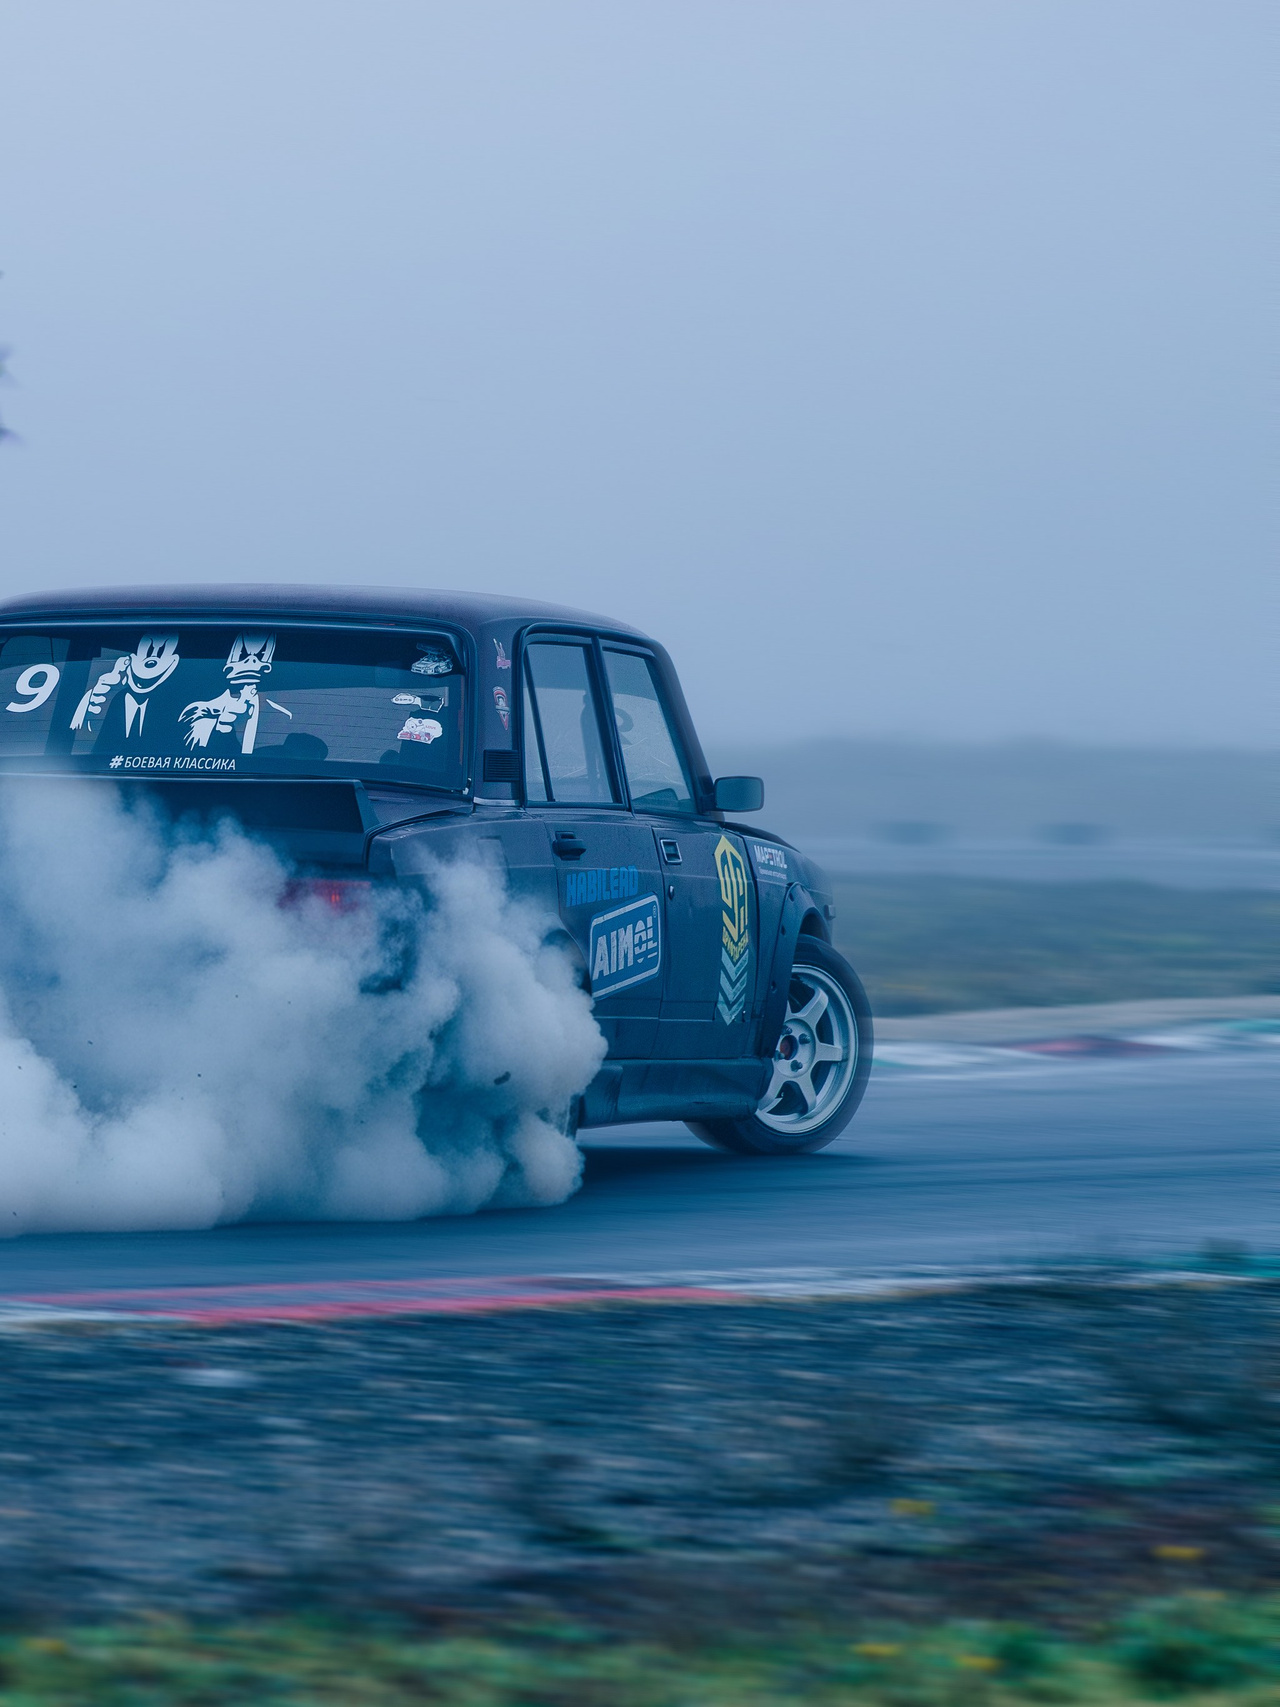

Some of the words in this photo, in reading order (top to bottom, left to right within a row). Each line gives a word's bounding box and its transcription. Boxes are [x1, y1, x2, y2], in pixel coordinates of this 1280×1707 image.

[5, 663, 61, 713] 9
[109, 755, 172, 769] #БОЕВАЯ
[173, 757, 237, 771] КЛАССИКА
[753, 844, 788, 869] MAPETROL
[565, 865, 639, 908] HABILEAD
[592, 915, 658, 981] AIMOL
